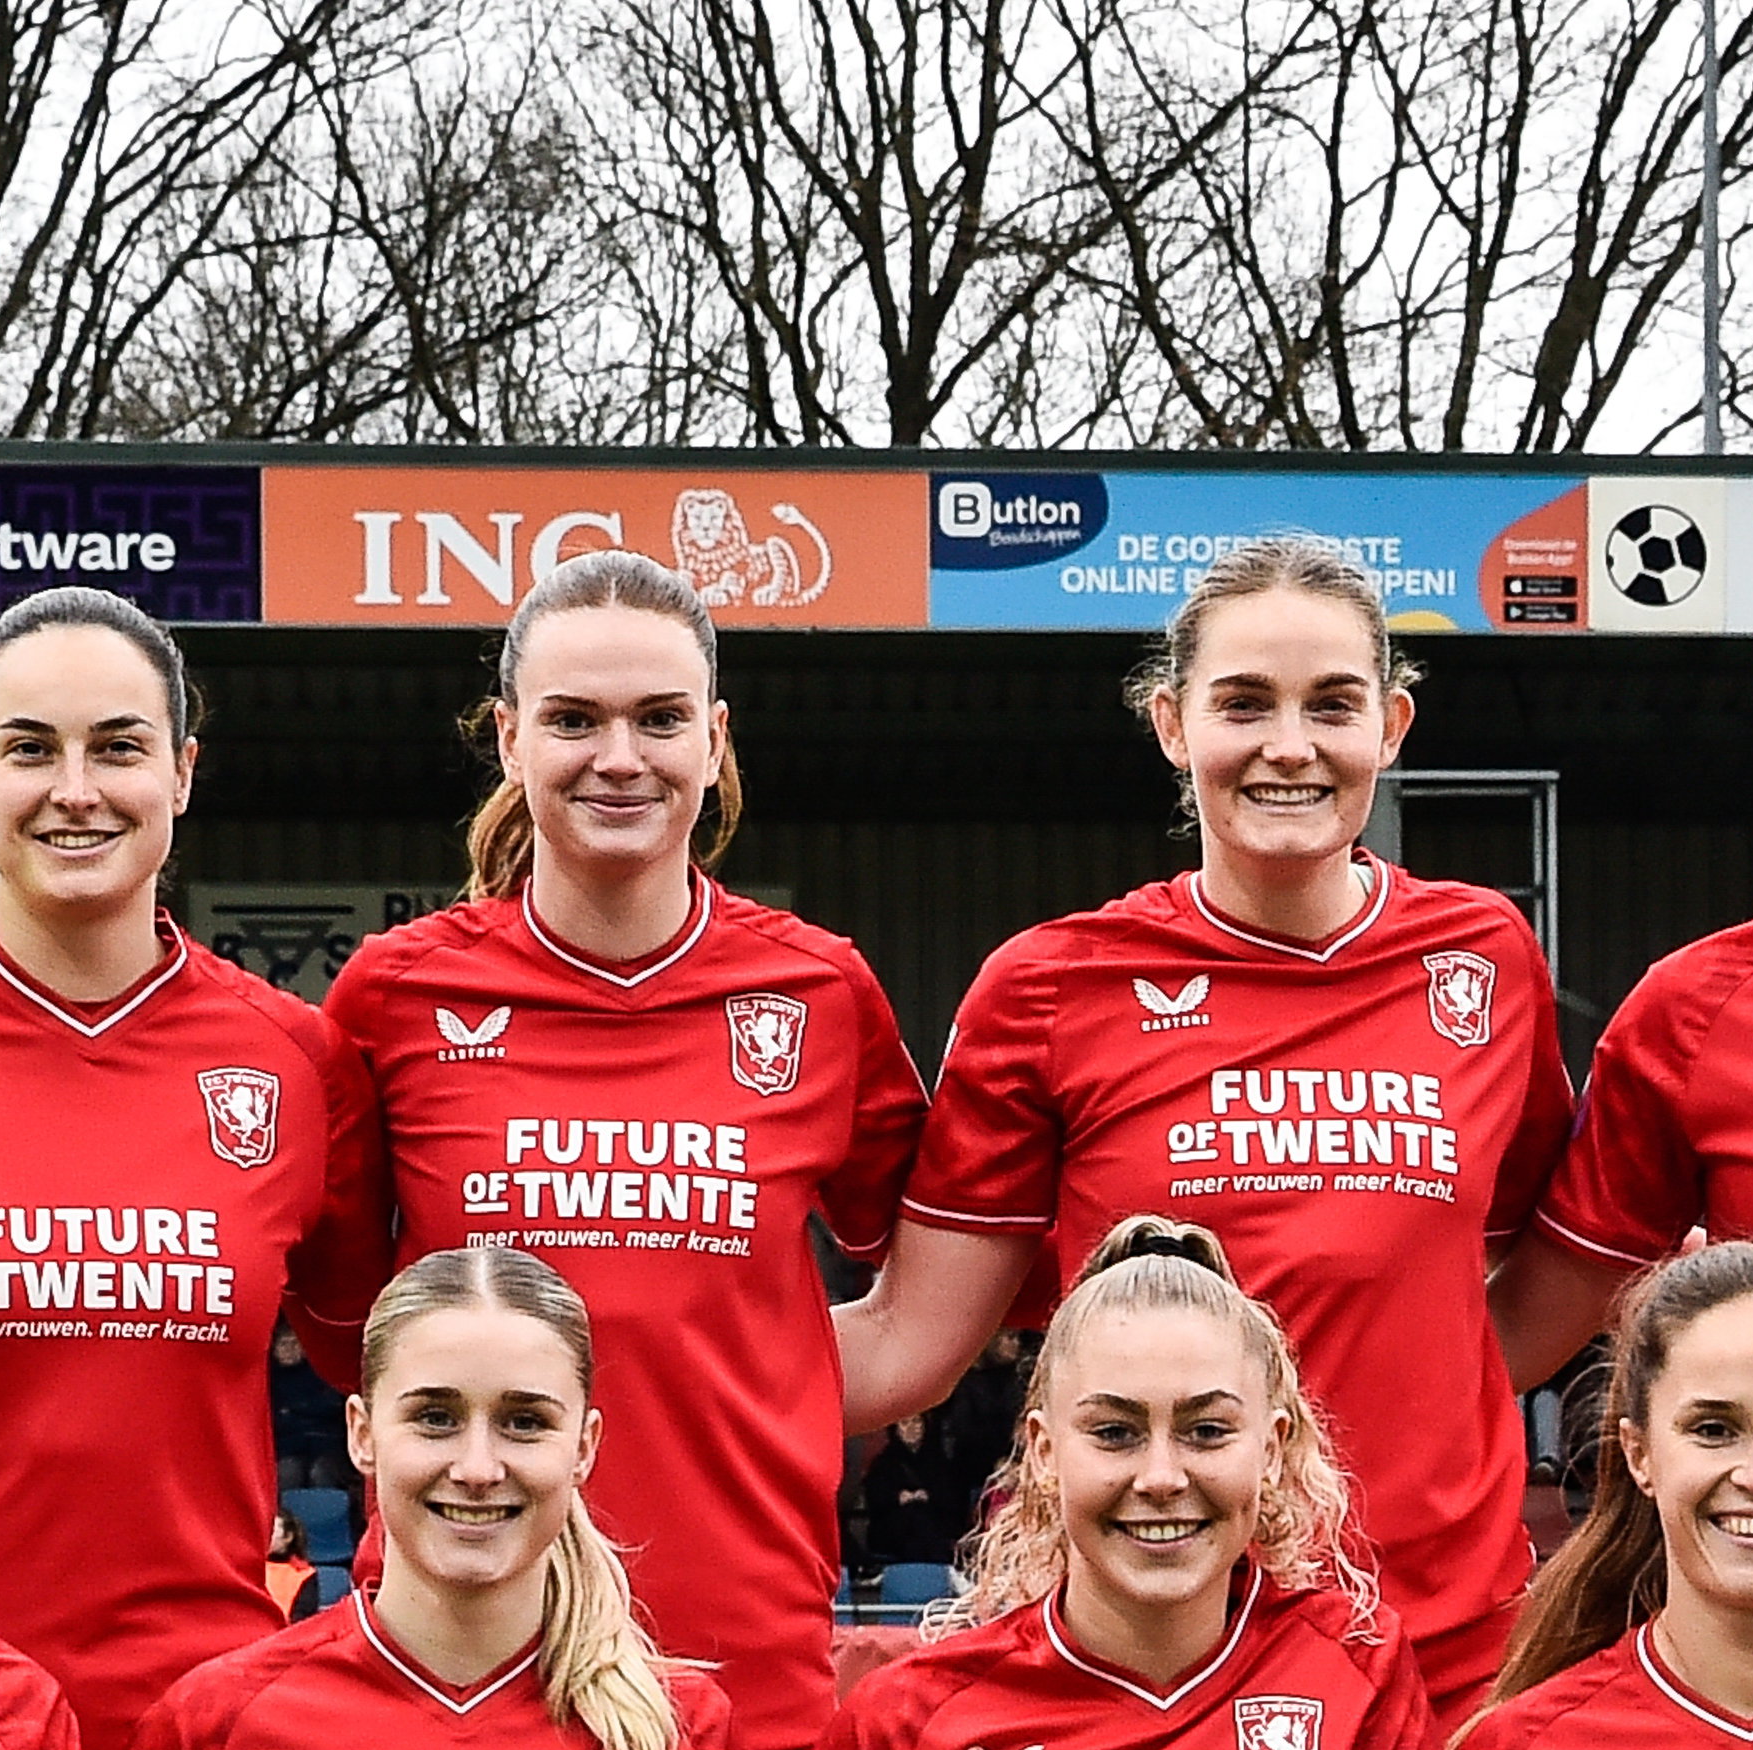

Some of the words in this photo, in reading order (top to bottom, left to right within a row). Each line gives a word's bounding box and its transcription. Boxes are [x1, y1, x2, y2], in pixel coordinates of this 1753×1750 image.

[1118, 535, 1159, 562] DE
[1060, 566, 1176, 594] ONLINE
[1210, 1069, 1443, 1120] FUTURE
[505, 1118, 747, 1174] FUTURE
[1167, 1121, 1219, 1164] OF
[1220, 1118, 1459, 1175] TWENTE
[463, 1172, 509, 1214] OF
[513, 1171, 758, 1230] TWENTE
[1170, 1175, 1229, 1199] meer
[1333, 1175, 1392, 1193] meer
[1393, 1173, 1456, 1203] kracht.
[466, 1230, 519, 1249] meer
[523, 1229, 620, 1248] vrouwen.
[625, 1230, 684, 1251] meer
[686, 1231, 751, 1257] kracht.
[99, 1320, 158, 1339] meer
[162, 1318, 231, 1343] kracht.
